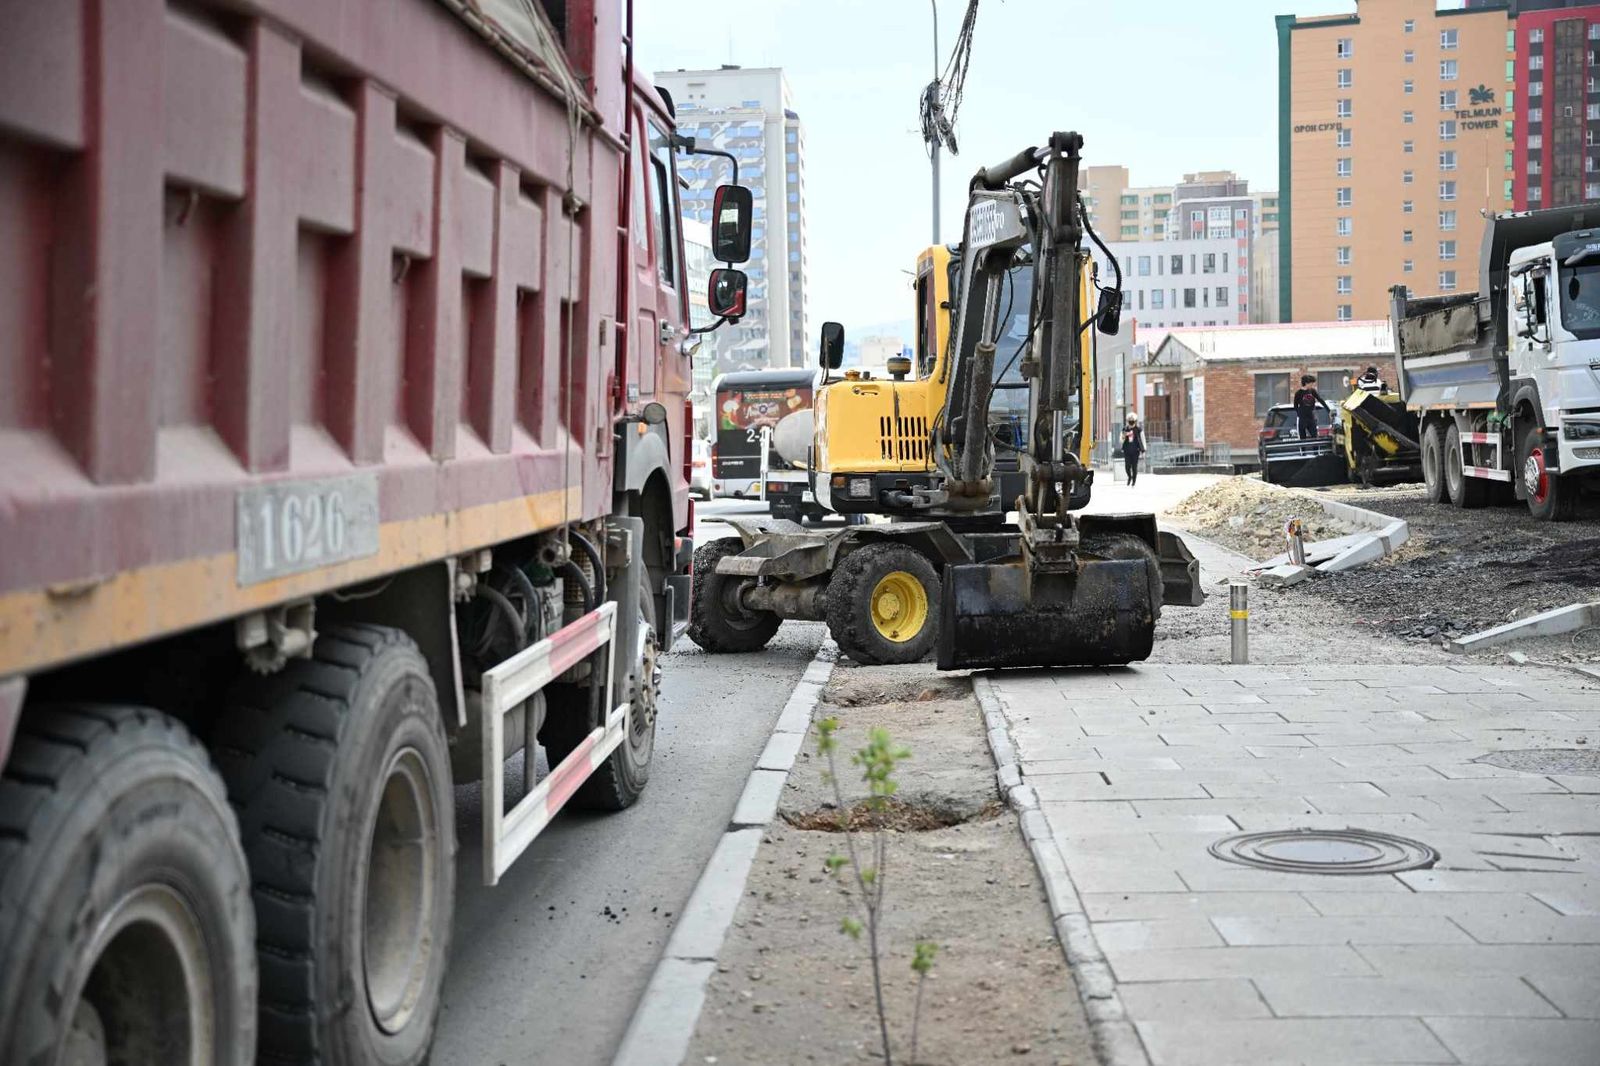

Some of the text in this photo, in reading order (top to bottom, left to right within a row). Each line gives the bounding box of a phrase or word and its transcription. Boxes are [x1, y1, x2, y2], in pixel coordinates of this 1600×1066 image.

[1455, 107, 1501, 119] TELMUUN
[1461, 120, 1498, 130] TOWER
[260, 491, 345, 569] 1626
